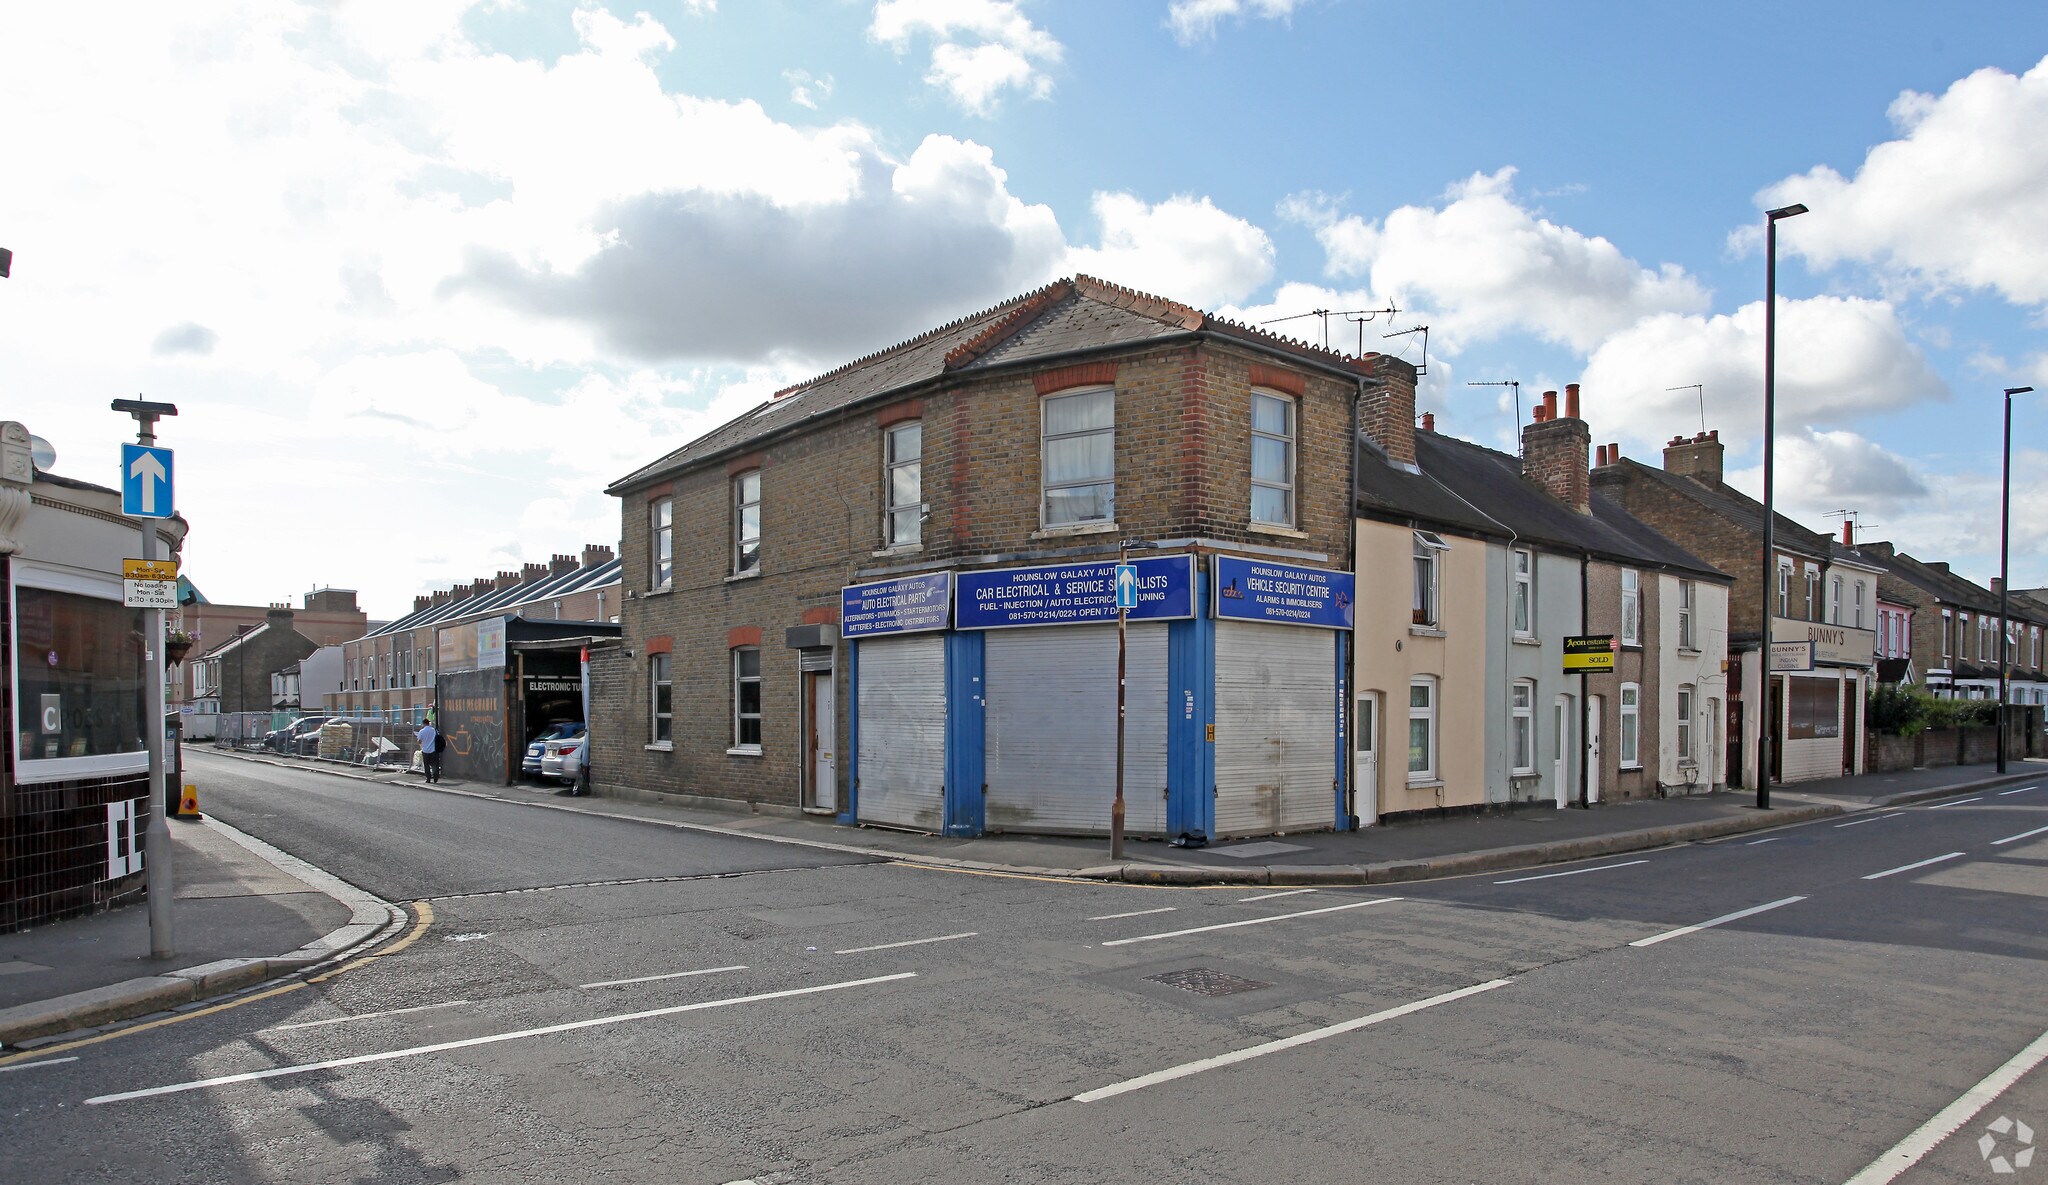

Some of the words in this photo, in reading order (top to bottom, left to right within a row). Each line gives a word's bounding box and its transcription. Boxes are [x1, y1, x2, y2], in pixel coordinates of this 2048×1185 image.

[1013, 572, 1058, 582] HOUNSLOW
[1060, 569, 1095, 579] GALAXY
[1251, 567, 1282, 578] HOUNSLOW
[1284, 570, 1308, 580] GALAXY
[1309, 574, 1326, 583] AUTOS
[862, 588, 887, 597] HOUNSLOW
[888, 584, 908, 593] GALAXY
[909, 582, 926, 590] AUTOS
[976, 588, 994, 600] CAR
[996, 584, 1049, 599] ELECTRICAL
[1054, 583, 1060, 595] &
[1066, 580, 1104, 594] SERVICE
[1247, 578, 1273, 592] VEHICLE
[1275, 581, 1306, 595] SECURITY
[1306, 586, 1330, 598] CENTRE
[862, 599, 876, 610] AUTO
[877, 595, 907, 608] ELECTRICAL
[908, 592, 926, 604] PARTS
[1074, 596, 1116, 605] ELECTRICA
[1256, 595, 1280, 604] ALARMS
[1286, 598, 1322, 608] IMMOBILISERS
[844, 612, 874, 622] ALTERNATORS
[877, 610, 900, 618] DYNAMOS
[1079, 608, 1101, 616] OPEN
[849, 622, 872, 632] BATTERIES
[875, 619, 903, 628] ELECTRONIC
[905, 616, 940, 626] DISTRIBUTORS
[1808, 627, 1844, 645] BUNNY'S
[530, 682, 571, 691] ELECTRONIC
